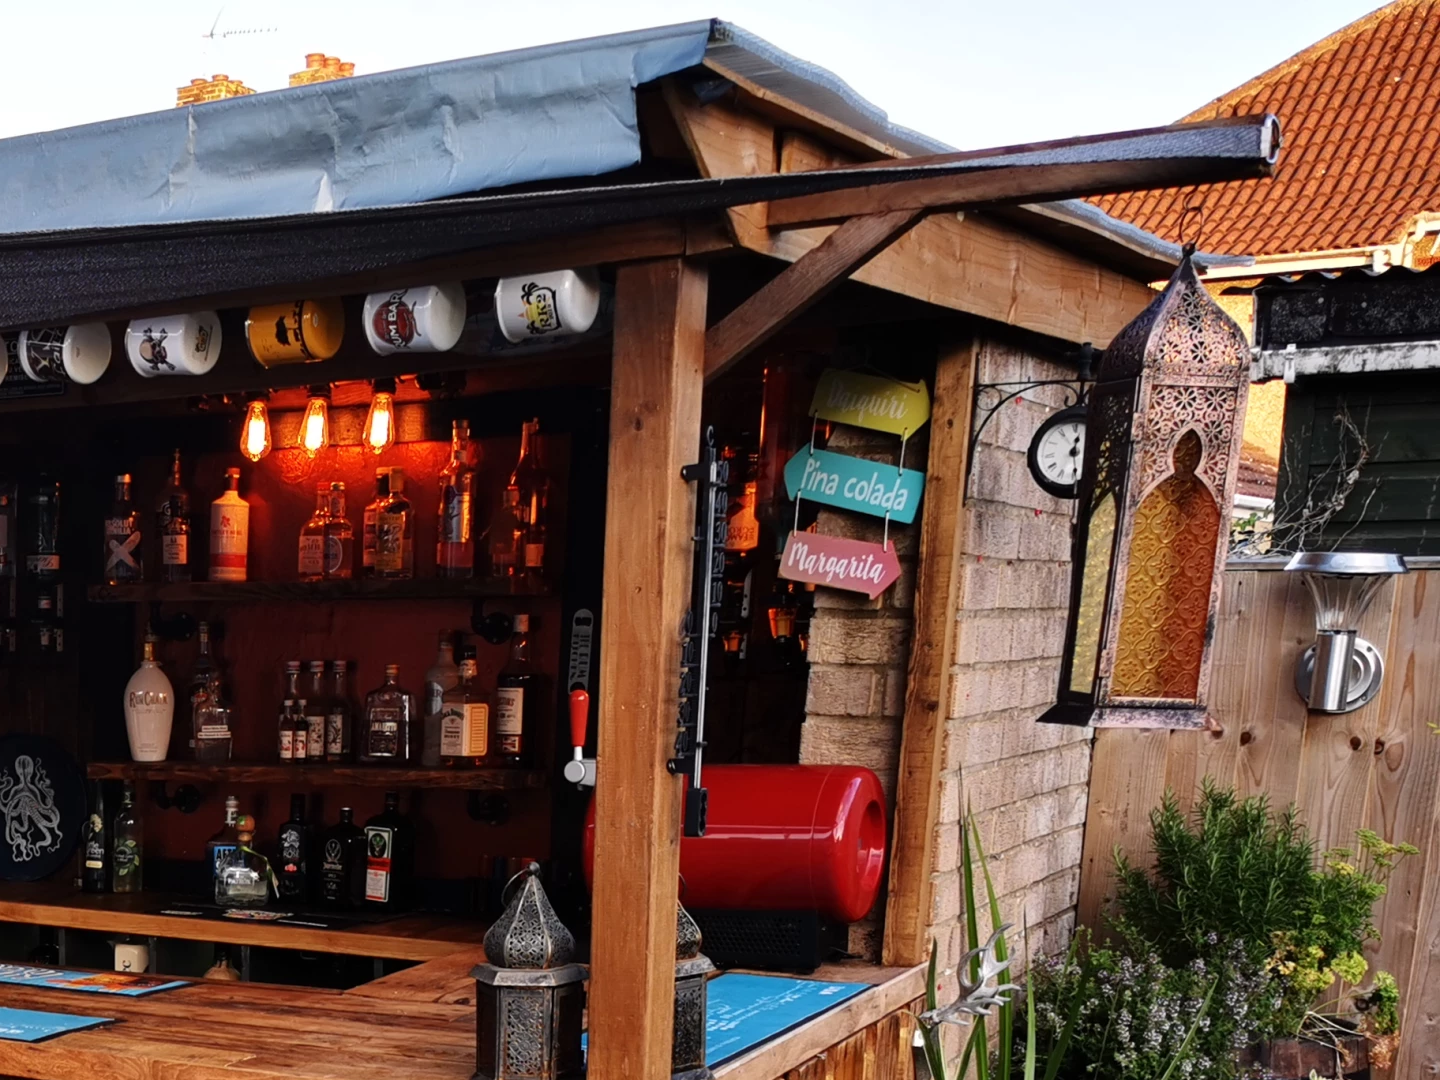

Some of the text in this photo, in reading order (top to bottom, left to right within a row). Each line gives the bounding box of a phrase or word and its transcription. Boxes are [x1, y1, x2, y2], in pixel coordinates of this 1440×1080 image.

[387, 290, 406, 349] RUM BAR
[535, 293, 552, 328] RK2
[826, 378, 908, 423] Daiquiri
[799, 458, 909, 511] Pina colada
[713, 552, 725, 573] 20
[788, 541, 886, 584] Margarita
[712, 581, 723, 603] 10
